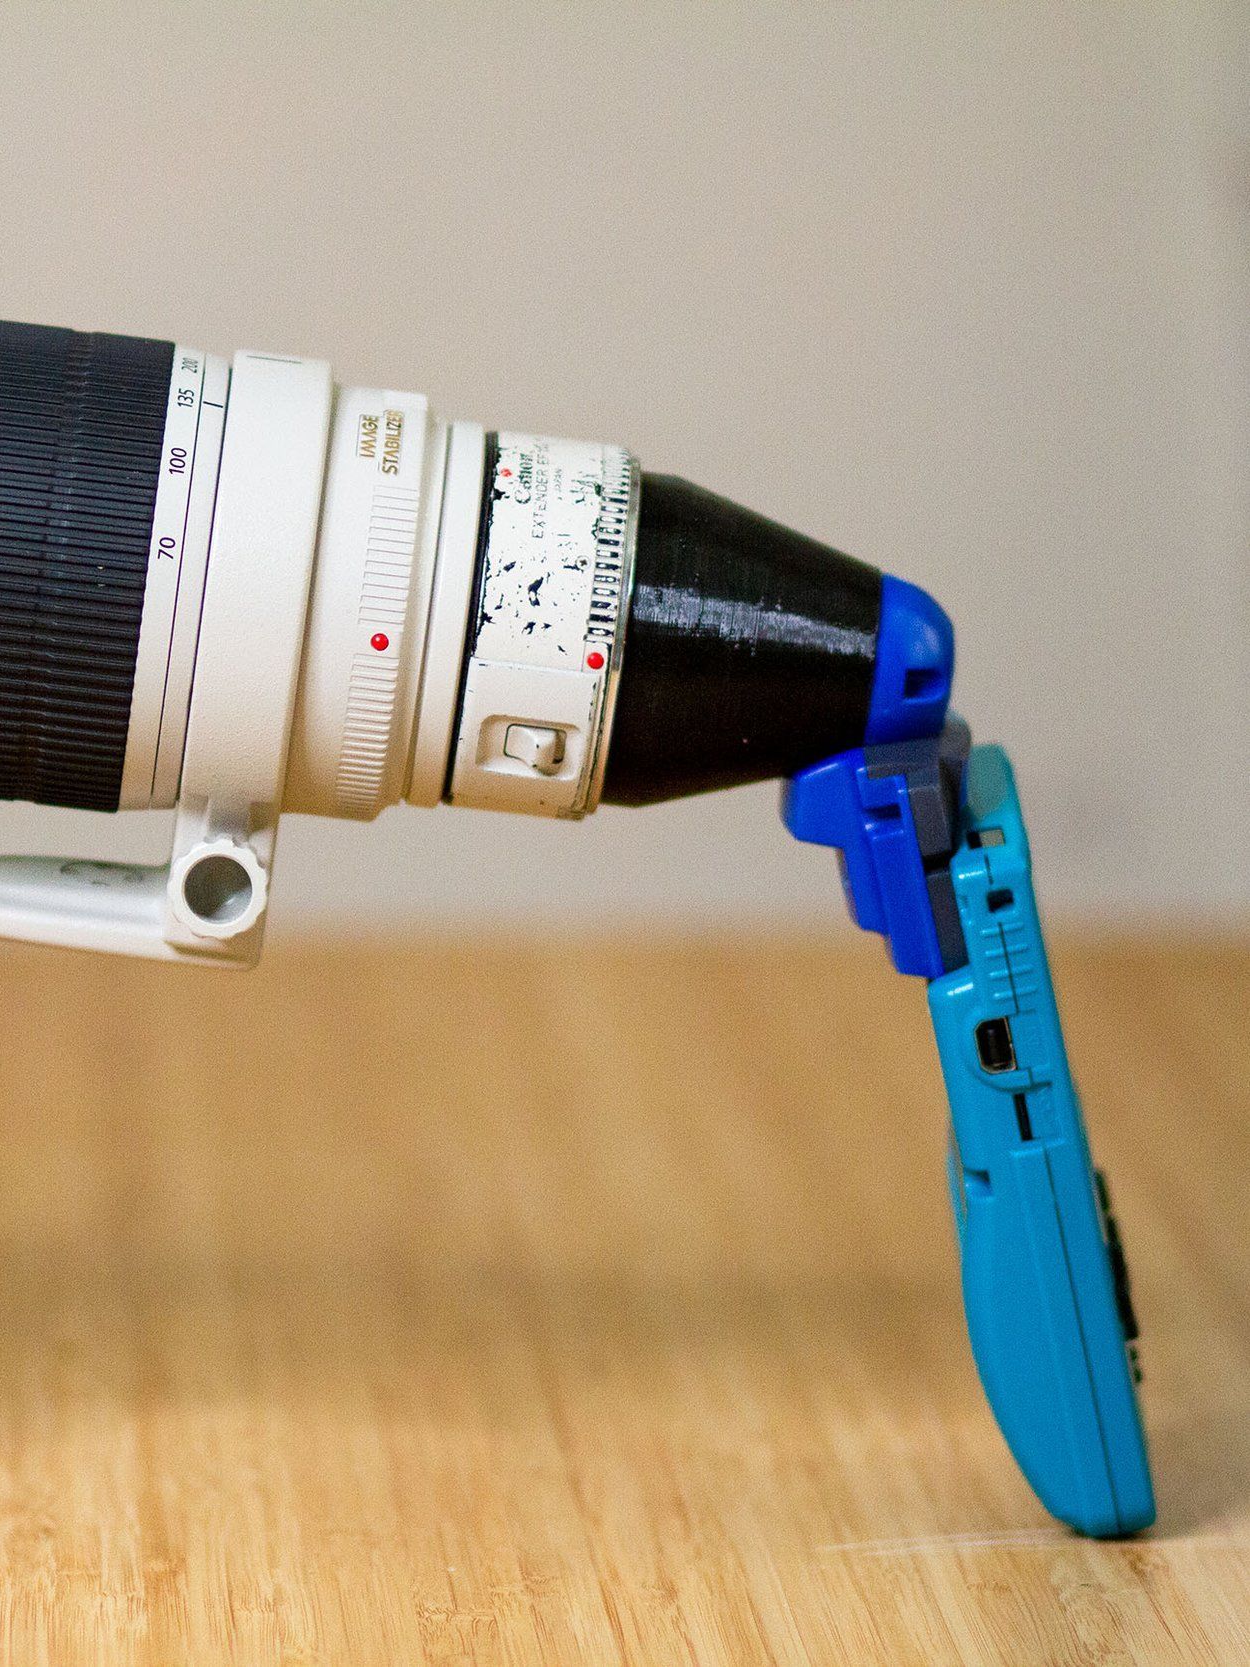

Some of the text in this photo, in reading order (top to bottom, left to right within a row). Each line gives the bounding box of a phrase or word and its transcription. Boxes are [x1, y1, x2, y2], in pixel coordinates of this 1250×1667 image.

[181, 357, 198, 373] 200
[177, 388, 194, 408] 135
[360, 415, 379, 457] IMAGE
[169, 447, 187, 475] 100
[158, 537, 176, 560] 70
